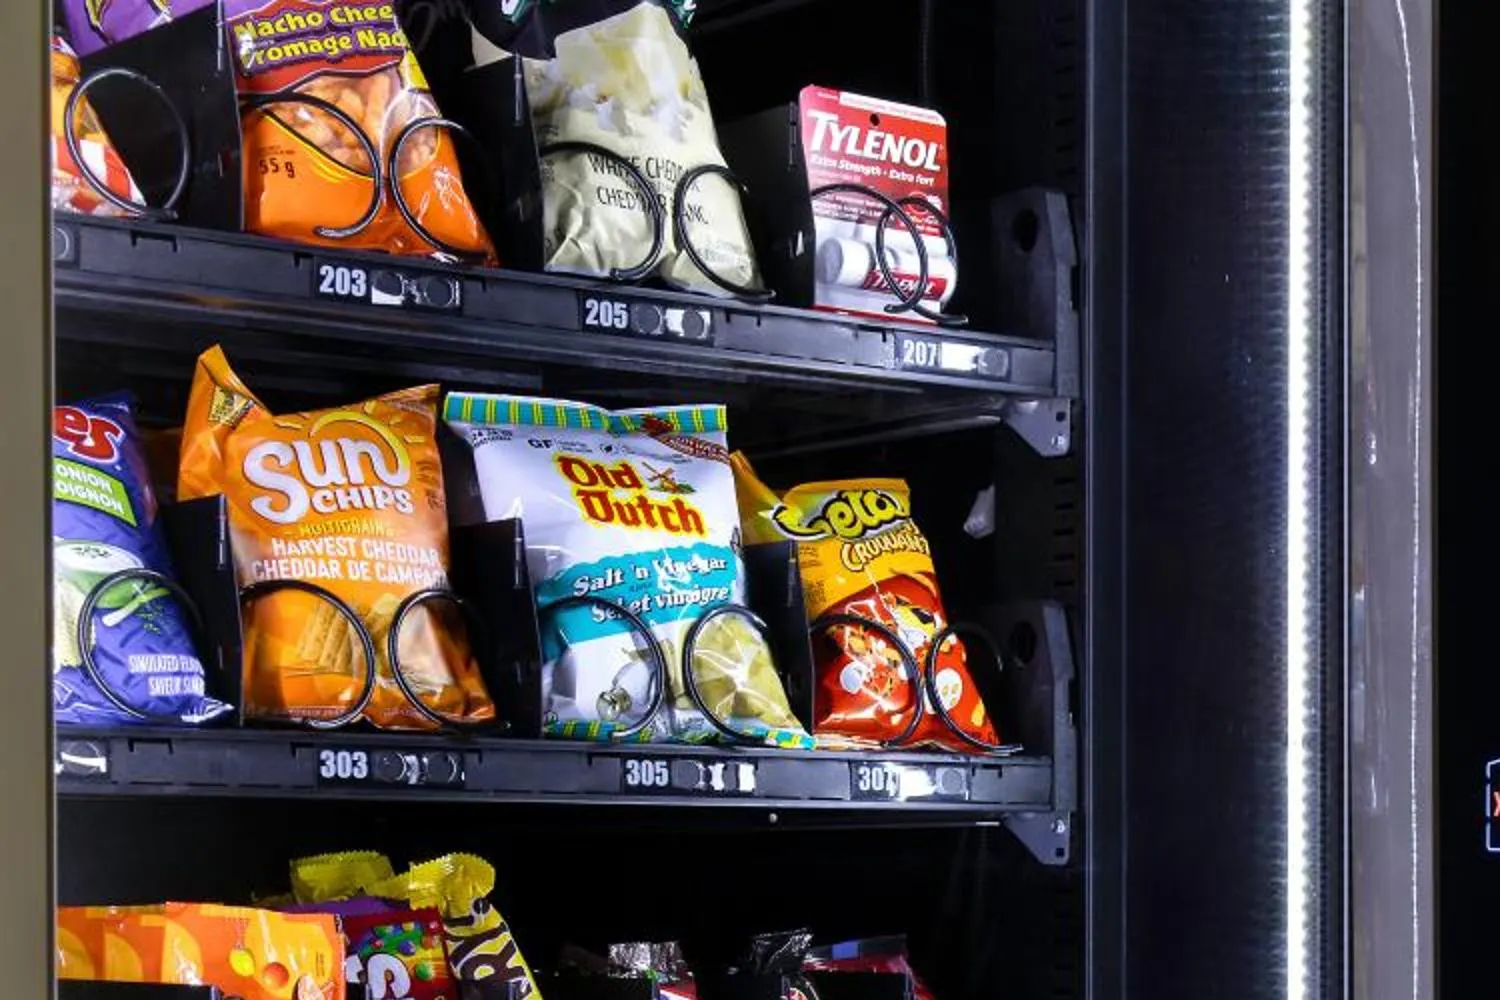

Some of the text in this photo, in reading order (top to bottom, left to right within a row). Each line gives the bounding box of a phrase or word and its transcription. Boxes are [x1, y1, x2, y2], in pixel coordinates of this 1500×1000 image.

[234, 10, 324, 38] Nacho
[806, 108, 942, 172] TYLENOL
[587, 152, 641, 174] WHE
[837, 159, 883, 177] Strength
[596, 185, 668, 216] CHEDR
[318, 265, 367, 298] 203
[584, 300, 629, 329] 205
[902, 340, 940, 367] 207
[242, 428, 411, 525] Sun
[557, 454, 644, 490] Old
[311, 484, 415, 515] CHIPS
[575, 488, 707, 536] Dutch
[271, 535, 442, 566] HARVEST CHEDDAR
[252, 557, 344, 581] CHEDDAR
[346, 560, 372, 581] DE
[572, 566, 626, 598] Salt
[319, 749, 369, 780] 303
[625, 758, 669, 788] 305
[858, 766, 898, 796] 307
